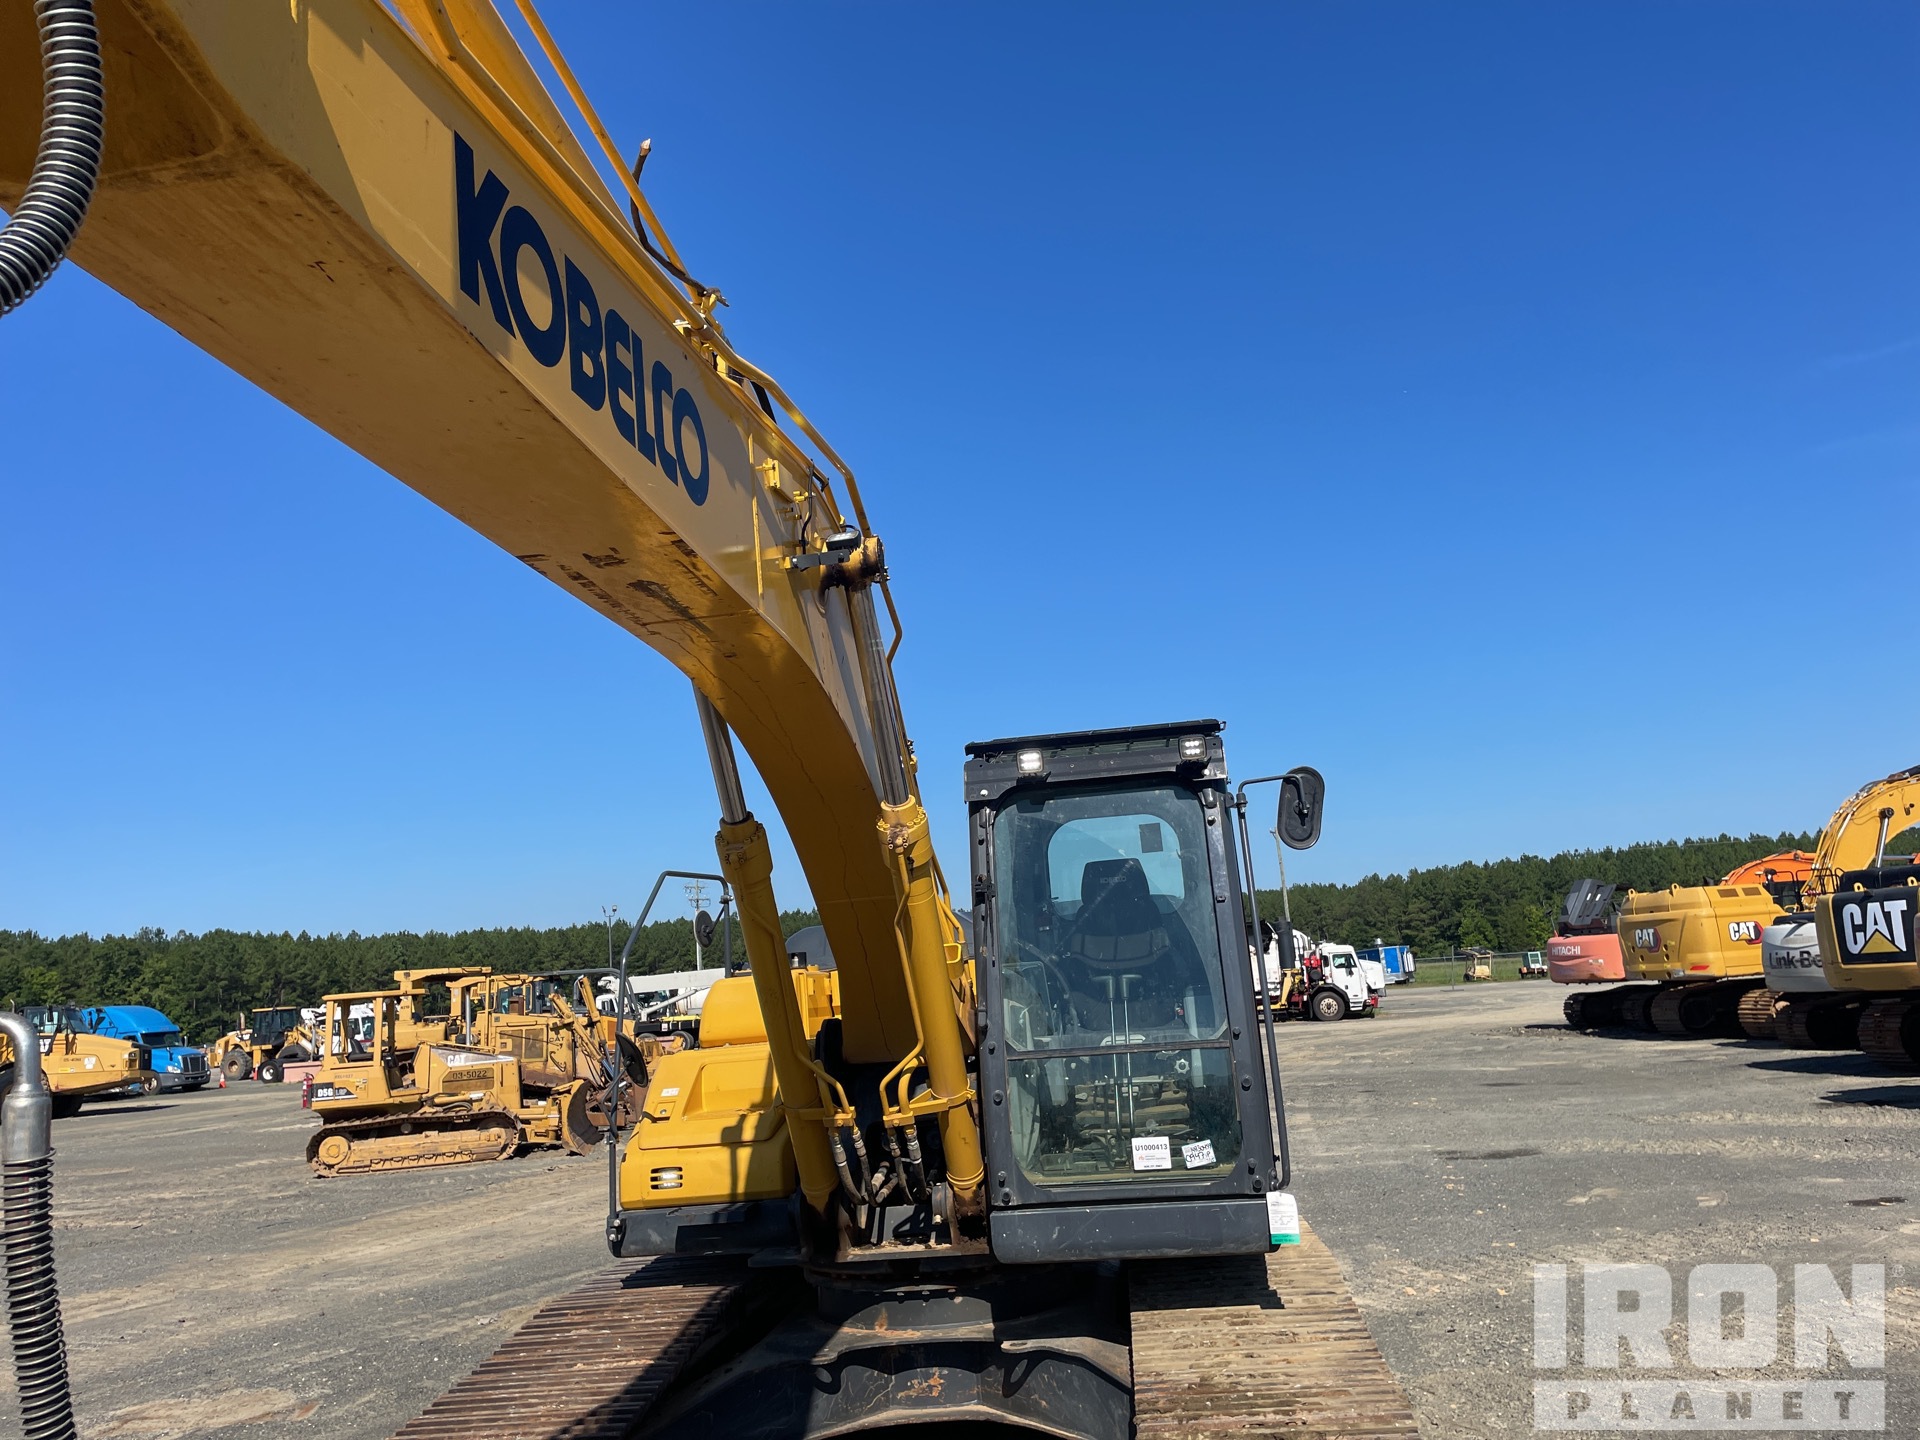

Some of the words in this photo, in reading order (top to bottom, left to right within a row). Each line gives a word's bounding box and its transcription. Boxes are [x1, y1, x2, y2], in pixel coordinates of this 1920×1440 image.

[454, 129, 710, 507] KOBELCO
[1728, 921, 1756, 942] CAT
[1842, 899, 1908, 955] CAT
[1635, 928, 1655, 948] CAT
[1551, 945, 1581, 956] HITACHI
[1768, 950, 1823, 970] Link-Be
[447, 1055, 466, 1066] CAT
[452, 1070, 488, 1080] 03-5022
[1135, 1143, 1168, 1152] U1000413
